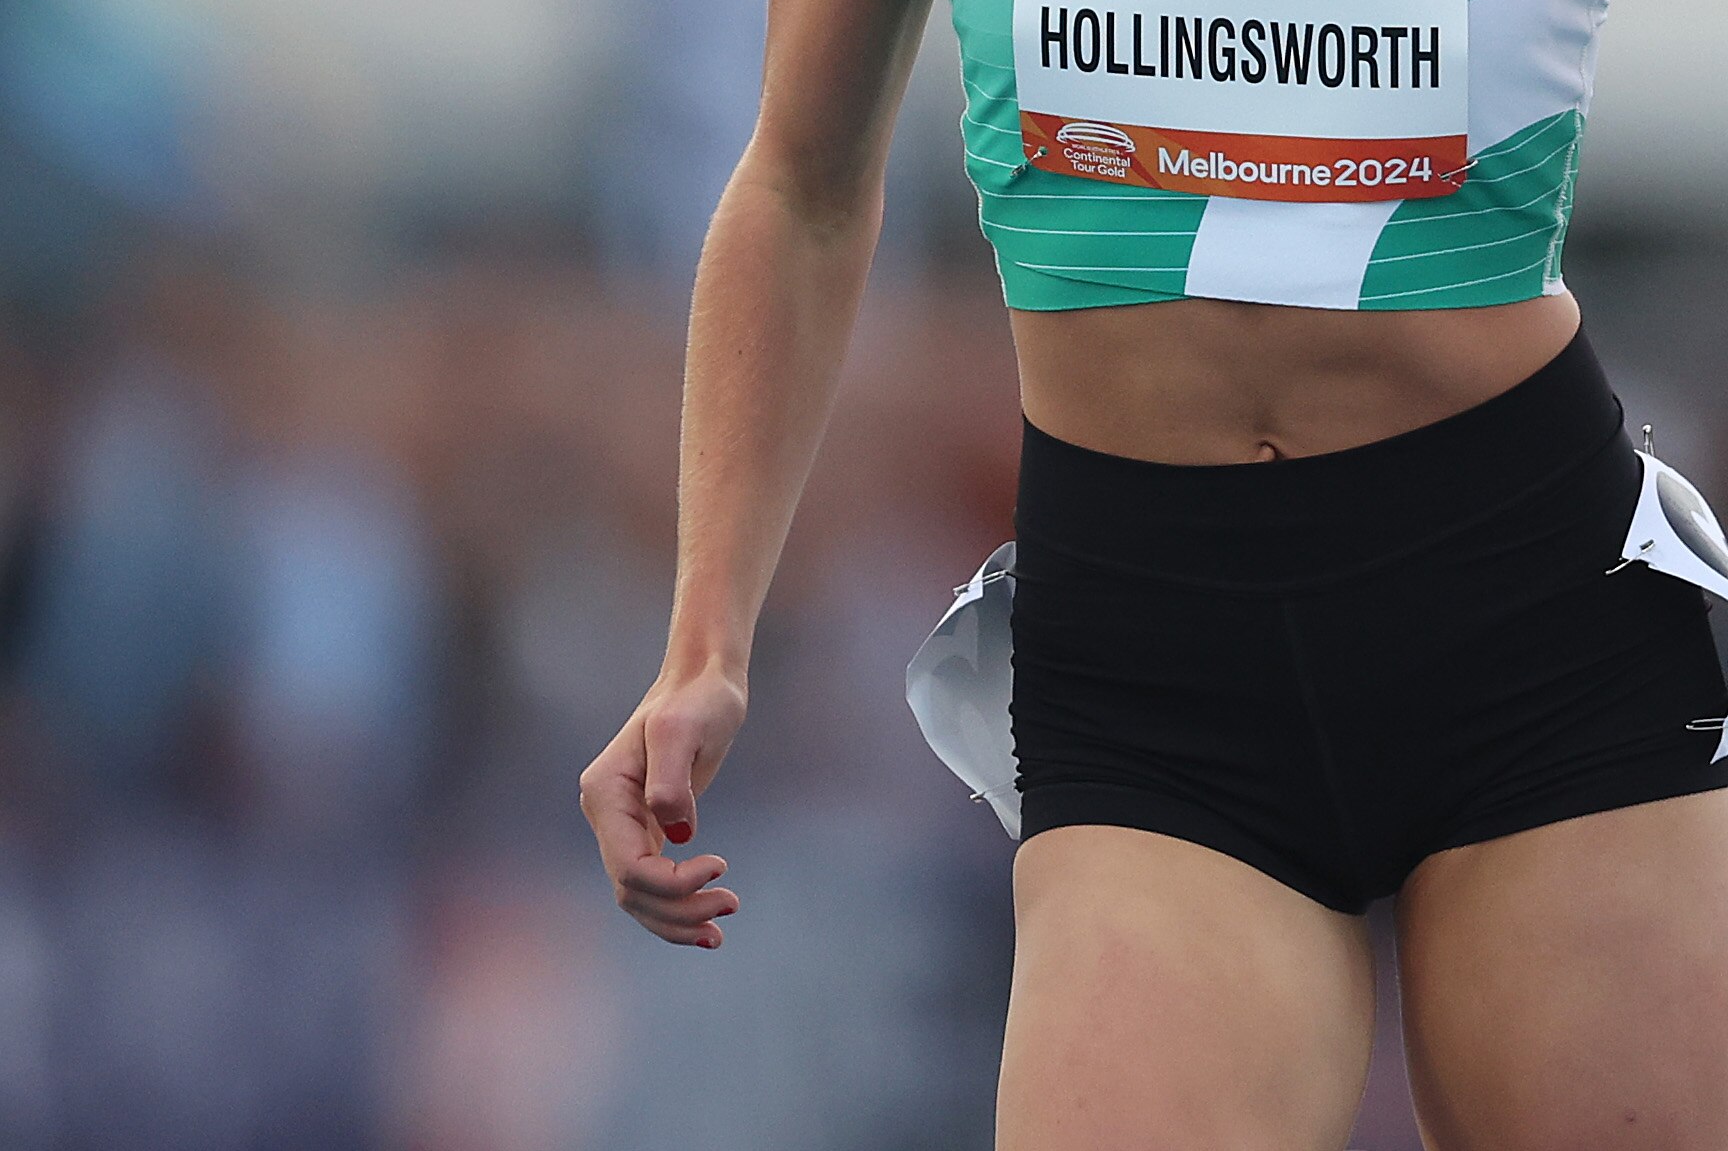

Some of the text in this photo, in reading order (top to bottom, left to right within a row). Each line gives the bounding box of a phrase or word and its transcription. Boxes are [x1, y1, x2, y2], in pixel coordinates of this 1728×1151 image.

[1040, 5, 1440, 89] HOLLINGSWORTH
[1063, 147, 1131, 168] Continental
[1070, 159, 1126, 179] Tour Gold
